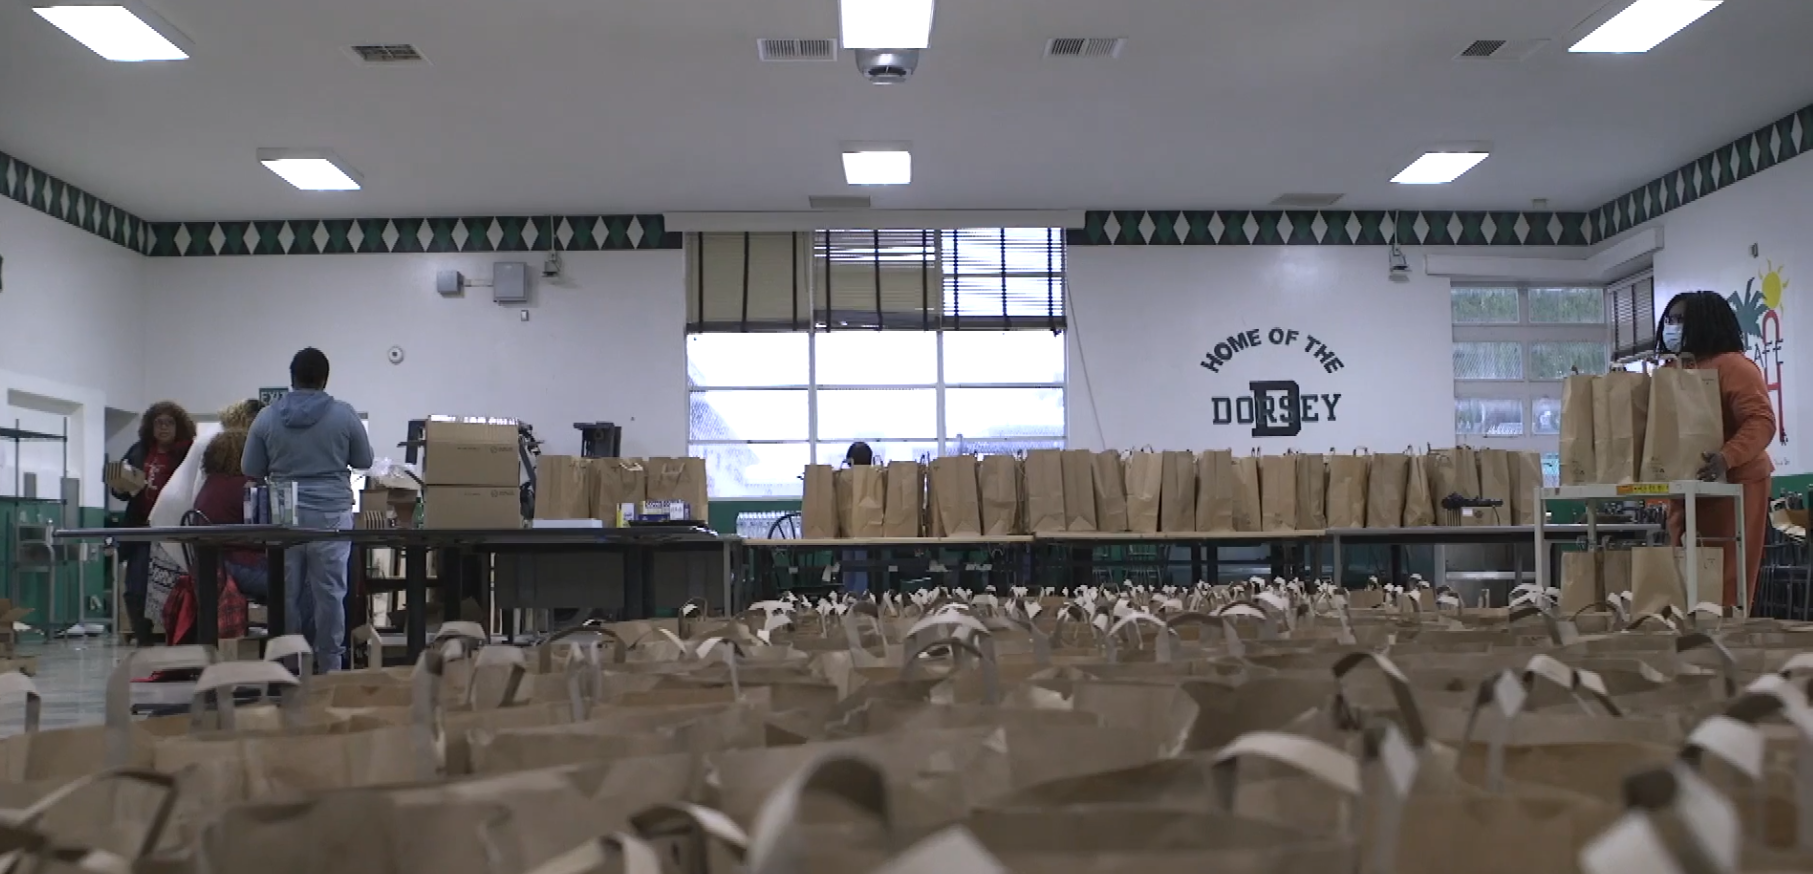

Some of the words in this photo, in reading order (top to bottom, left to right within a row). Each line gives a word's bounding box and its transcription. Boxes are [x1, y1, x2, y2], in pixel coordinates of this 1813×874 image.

[1200, 328, 1262, 373] HOME
[1268, 327, 1299, 345] OF
[1304, 334, 1345, 373] THE
[1211, 393, 1342, 424] DORSEY
